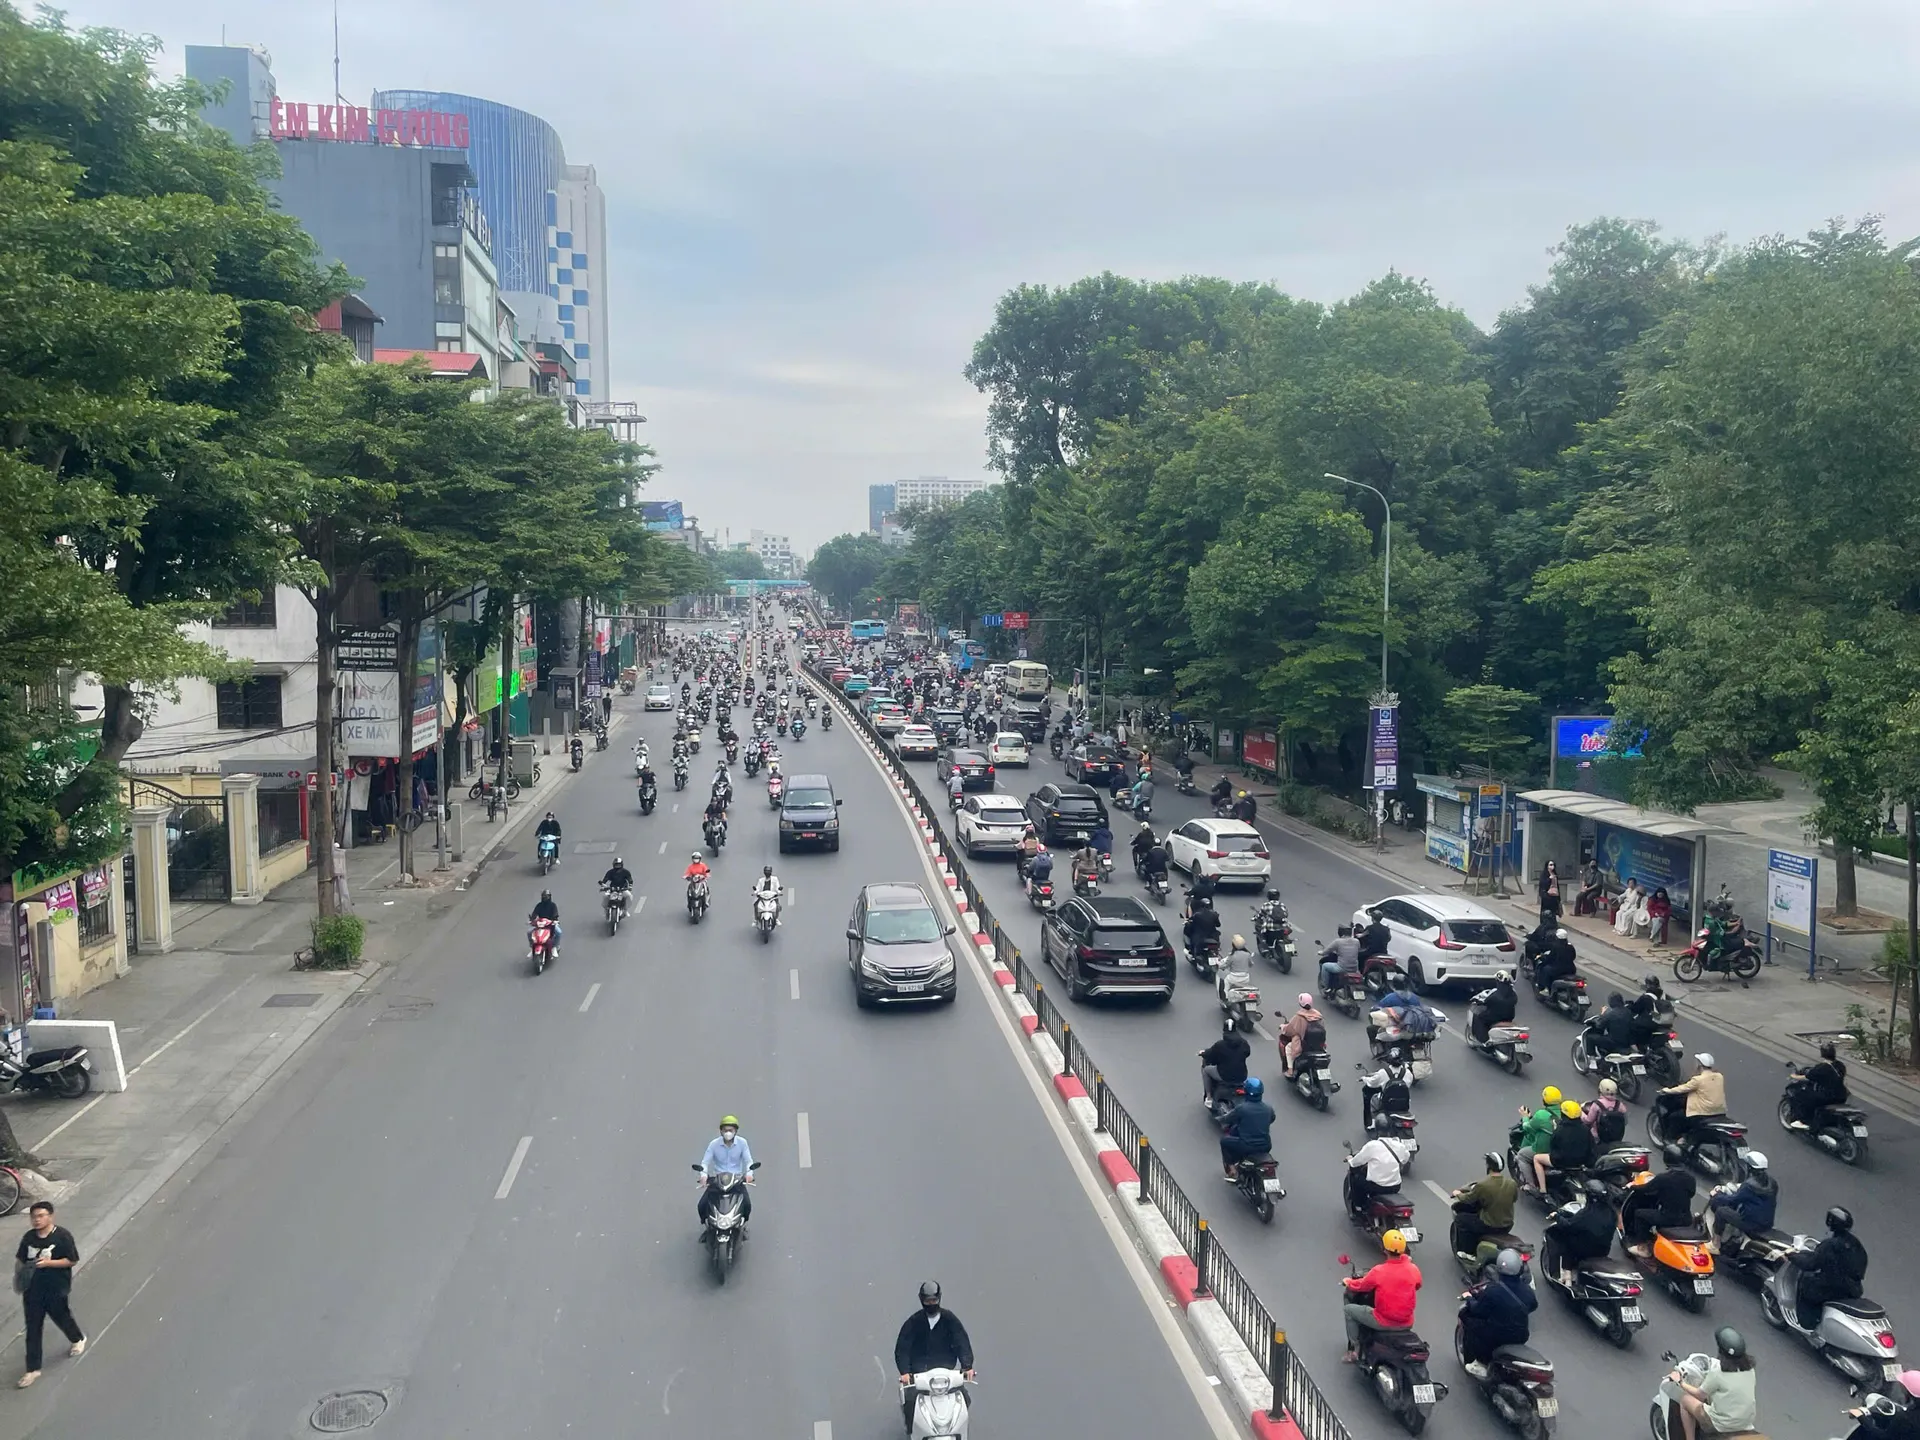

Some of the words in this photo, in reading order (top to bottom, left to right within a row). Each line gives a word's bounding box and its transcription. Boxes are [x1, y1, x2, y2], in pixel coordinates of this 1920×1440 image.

[317, 104, 368, 142] KIM
[377, 107, 469, 148] CƯƠNG
[347, 725, 362, 739] XE
